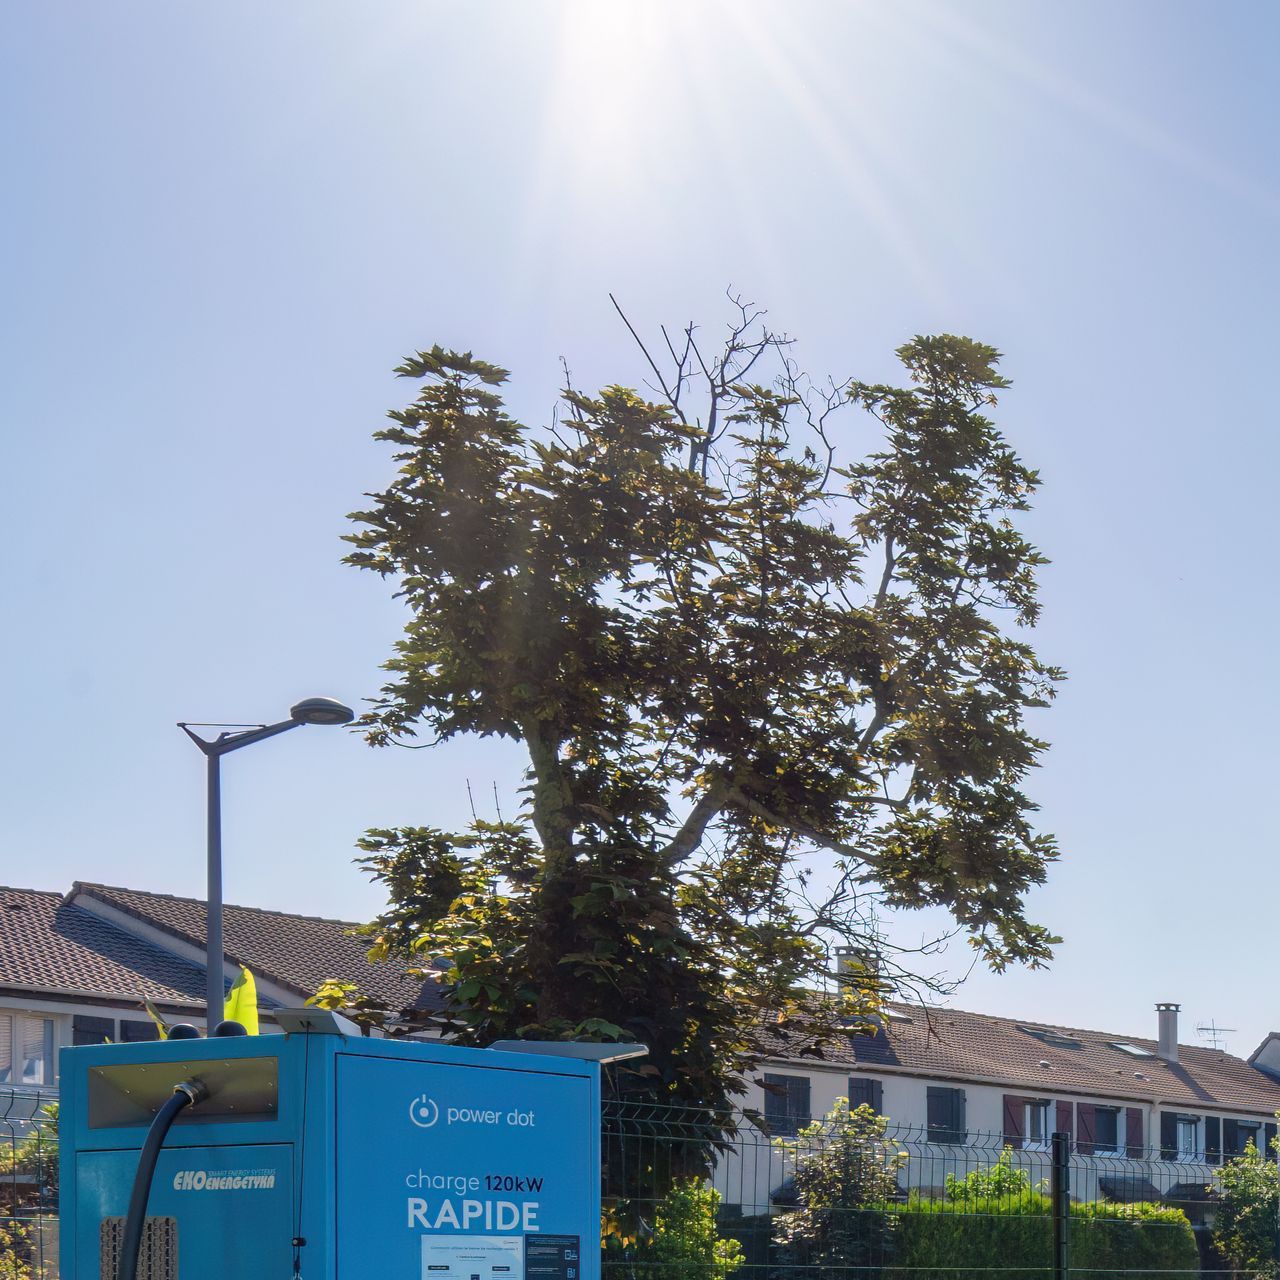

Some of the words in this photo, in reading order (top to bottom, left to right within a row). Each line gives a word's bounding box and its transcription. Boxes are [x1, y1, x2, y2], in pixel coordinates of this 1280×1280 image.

[447, 1107, 502, 1126] power
[506, 1108, 535, 1127] dot
[405, 1168, 480, 1196] charge
[485, 1175, 544, 1193] 120kW
[407, 1197, 540, 1232] RAPIDE
